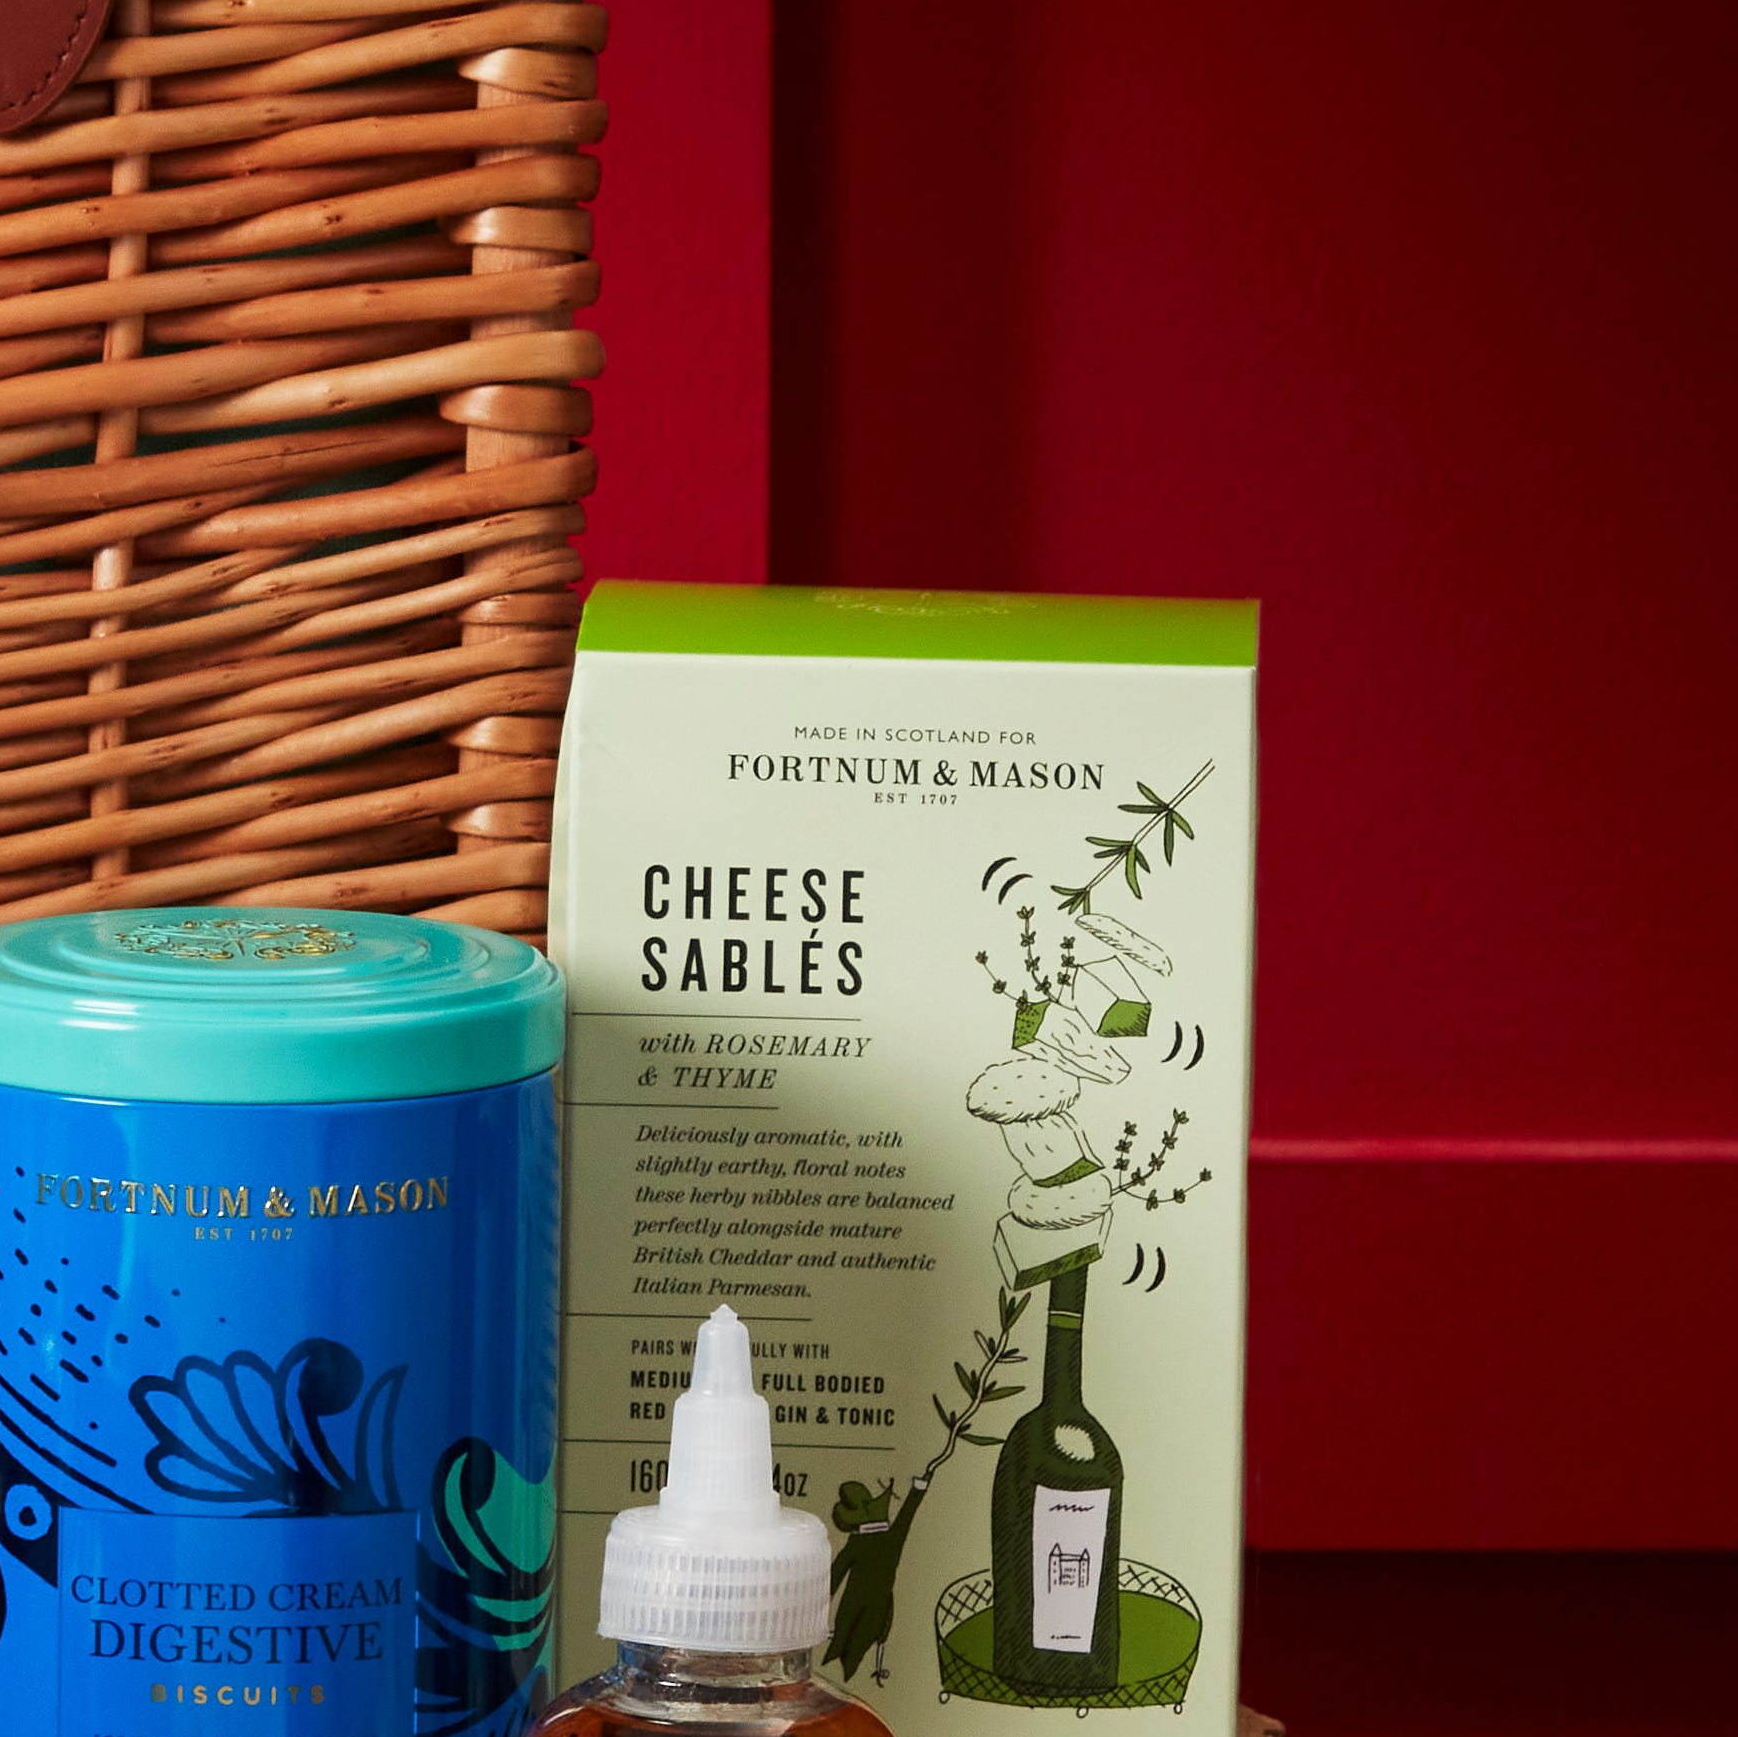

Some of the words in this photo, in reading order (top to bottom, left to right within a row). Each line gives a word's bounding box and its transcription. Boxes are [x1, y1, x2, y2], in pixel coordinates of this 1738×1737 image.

[795, 726, 849, 740] MADE
[857, 727, 877, 741] IN
[885, 728, 990, 743] SCOTLAND
[1000, 731, 1036, 744] FOR
[728, 754, 921, 785] FORTNUM
[932, 760, 958, 786] &
[970, 763, 1105, 789] MASON
[644, 865, 865, 923] CHEESE
[641, 929, 862, 996] SABLÉS
[639, 1032, 696, 1054] with
[705, 1034, 871, 1058] ROSEMARY
[638, 1067, 657, 1086] &
[672, 1067, 777, 1090] THYME
[635, 1125, 749, 1150] Deliciously
[754, 1128, 851, 1150] aromatic,
[857, 1128, 902, 1148] with
[635, 1154, 712, 1180] slightly
[717, 1158, 787, 1180] earthy,
[793, 1157, 848, 1178] floral
[853, 1161, 905, 1179] notes
[37, 1173, 248, 1218] FORTNUM
[263, 1187, 295, 1218] &
[308, 1176, 449, 1218] MASON
[635, 1186, 685, 1205] these
[690, 1187, 746, 1209] herby
[751, 1189, 823, 1207] nibbles
[827, 1193, 859, 1207] are
[865, 1190, 954, 1210] balanced
[633, 1216, 722, 1241] perfectly
[727, 1220, 824, 1242] alongside
[830, 1222, 901, 1239] mature
[633, 1246, 703, 1266] British
[708, 1247, 793, 1268] Cheddar
[797, 1250, 836, 1268] and
[841, 1251, 936, 1272] authentic
[633, 1277, 702, 1296] Italian
[708, 1278, 812, 1299] Parmesan.
[632, 1340, 674, 1355] PAIRS
[796, 1343, 829, 1359] WITH
[631, 1371, 691, 1388] MEDIU
[763, 1372, 808, 1393] FULL
[815, 1376, 885, 1394] BODIED
[631, 1403, 665, 1419] RED
[775, 1407, 811, 1425] GIN
[816, 1408, 829, 1425] &
[838, 1408, 895, 1427] TONIC
[71, 1575, 255, 1611] CLOTTED
[268, 1578, 402, 1611] CREAM
[91, 1620, 383, 1664] DIGESTIVE
[152, 1684, 325, 1705] BISCUITS
